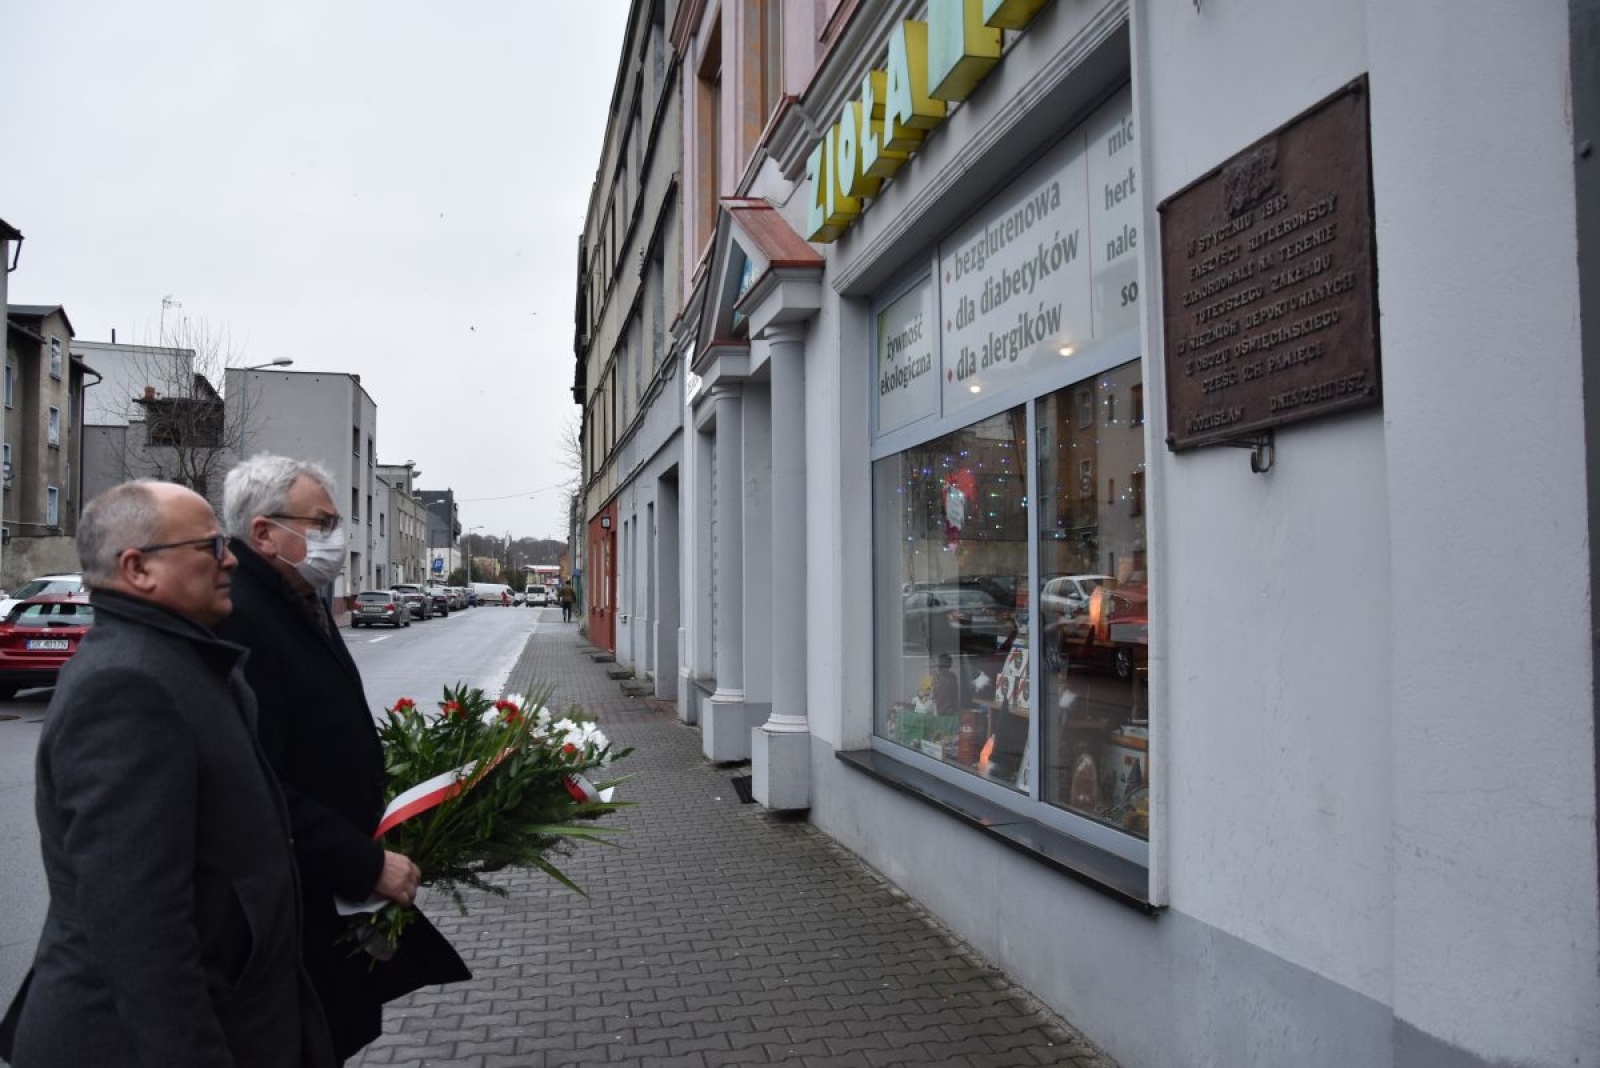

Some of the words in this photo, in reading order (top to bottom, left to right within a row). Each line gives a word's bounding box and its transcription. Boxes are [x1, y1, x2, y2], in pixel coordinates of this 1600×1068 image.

[806, 20, 914, 242] ZIOŁA
[954, 180, 1060, 283] bezglutenowa
[1198, 211, 1252, 253] STYCZNIU
[1247, 194, 1336, 252] HITLEROWSCY
[955, 294, 976, 332] dla
[980, 228, 1080, 307] diabetyków
[1183, 262, 1253, 306] ZAMORDOWALI
[1259, 255, 1272, 272] NA
[1279, 224, 1336, 263] TERENIE
[1193, 284, 1263, 325] TUTEJSZEGO
[1271, 254, 1332, 291] ZAKŁADU
[1245, 272, 1354, 329] DEPORTOWANYCH
[886, 312, 923, 362] żywność
[956, 347, 977, 383] dla
[981, 301, 1063, 364] alergików
[880, 351, 932, 396] ekologiczna
